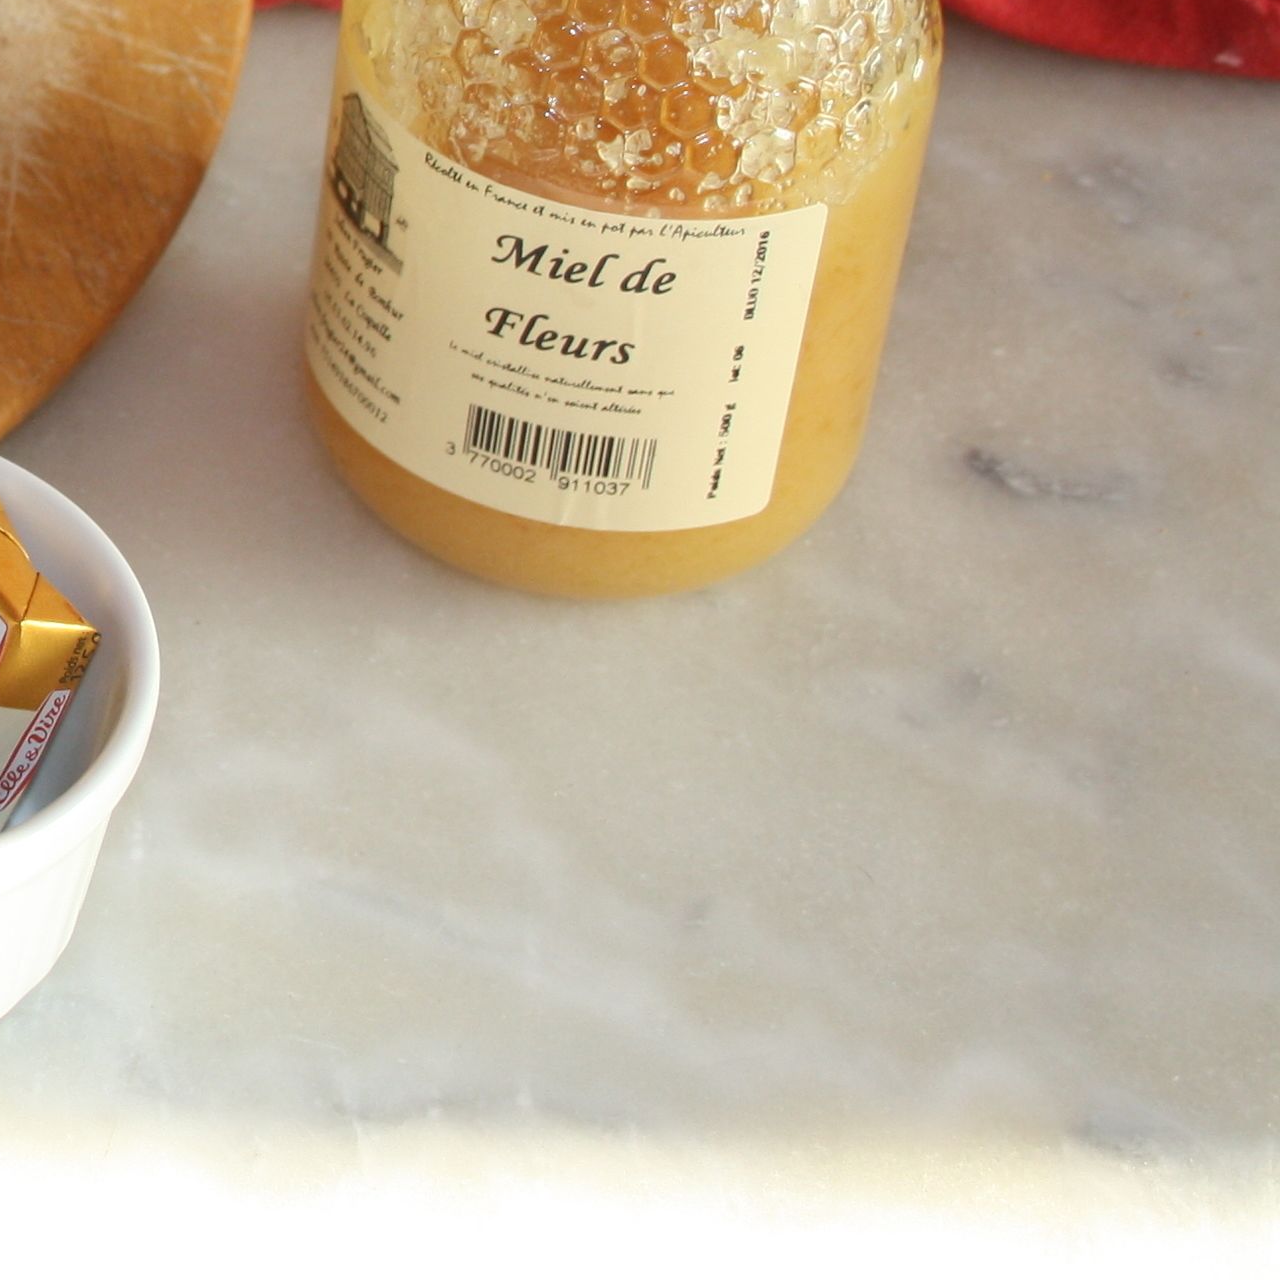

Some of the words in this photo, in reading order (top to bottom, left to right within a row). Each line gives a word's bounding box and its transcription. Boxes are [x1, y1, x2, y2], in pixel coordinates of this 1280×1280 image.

[484, 185, 527, 210] France
[533, 206, 545, 216] et
[601, 222, 626, 234] pot
[629, 226, 653, 239] par
[491, 235, 620, 287] Miel
[620, 258, 676, 295] de
[752, 230, 770, 284] 12/2016
[485, 307, 635, 365] Fleurs
[445, 441, 456, 455] 3
[468, 450, 537, 484] 770002
[557, 476, 631, 496] 911037
[28, 694, 66, 744] Vire
